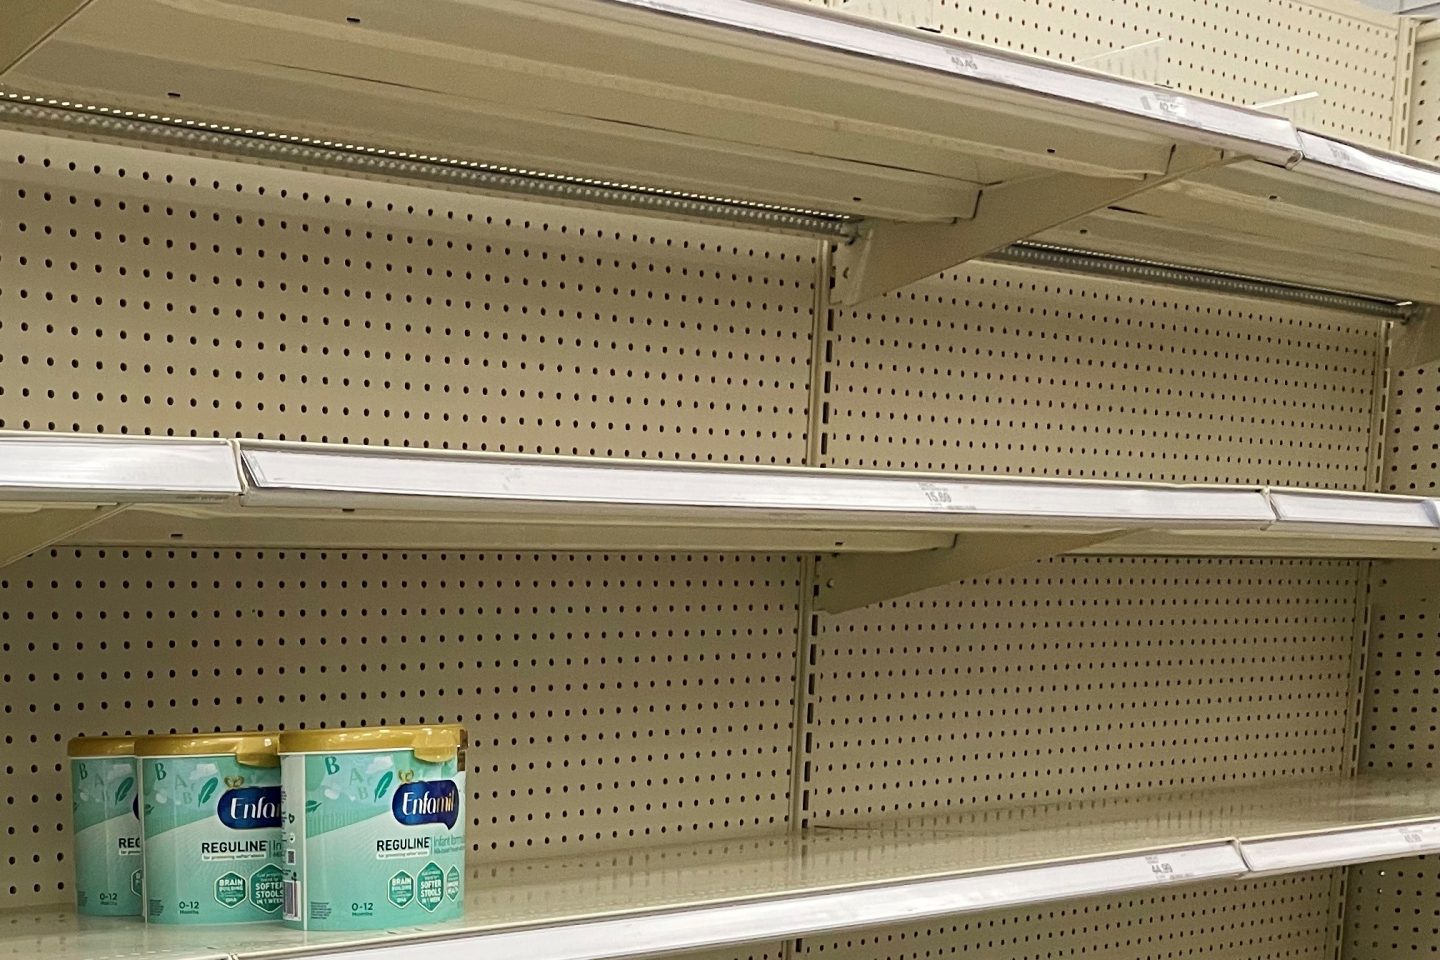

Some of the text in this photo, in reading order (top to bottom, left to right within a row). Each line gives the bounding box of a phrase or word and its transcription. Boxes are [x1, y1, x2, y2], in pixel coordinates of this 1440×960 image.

[402, 790, 455, 816] Enfamil
[230, 797, 282, 819] Enfa
[201, 840, 268, 853] REGULINE
[376, 837, 431, 852] REGULINE
[219, 878, 243, 887] BRAIN
[392, 877, 411, 886] BRAIN
[420, 880, 442, 889] SOFTER
[420, 888, 442, 897] STOOLS
[179, 901, 200, 909] 0-12
[351, 902, 374, 911] 0-12
